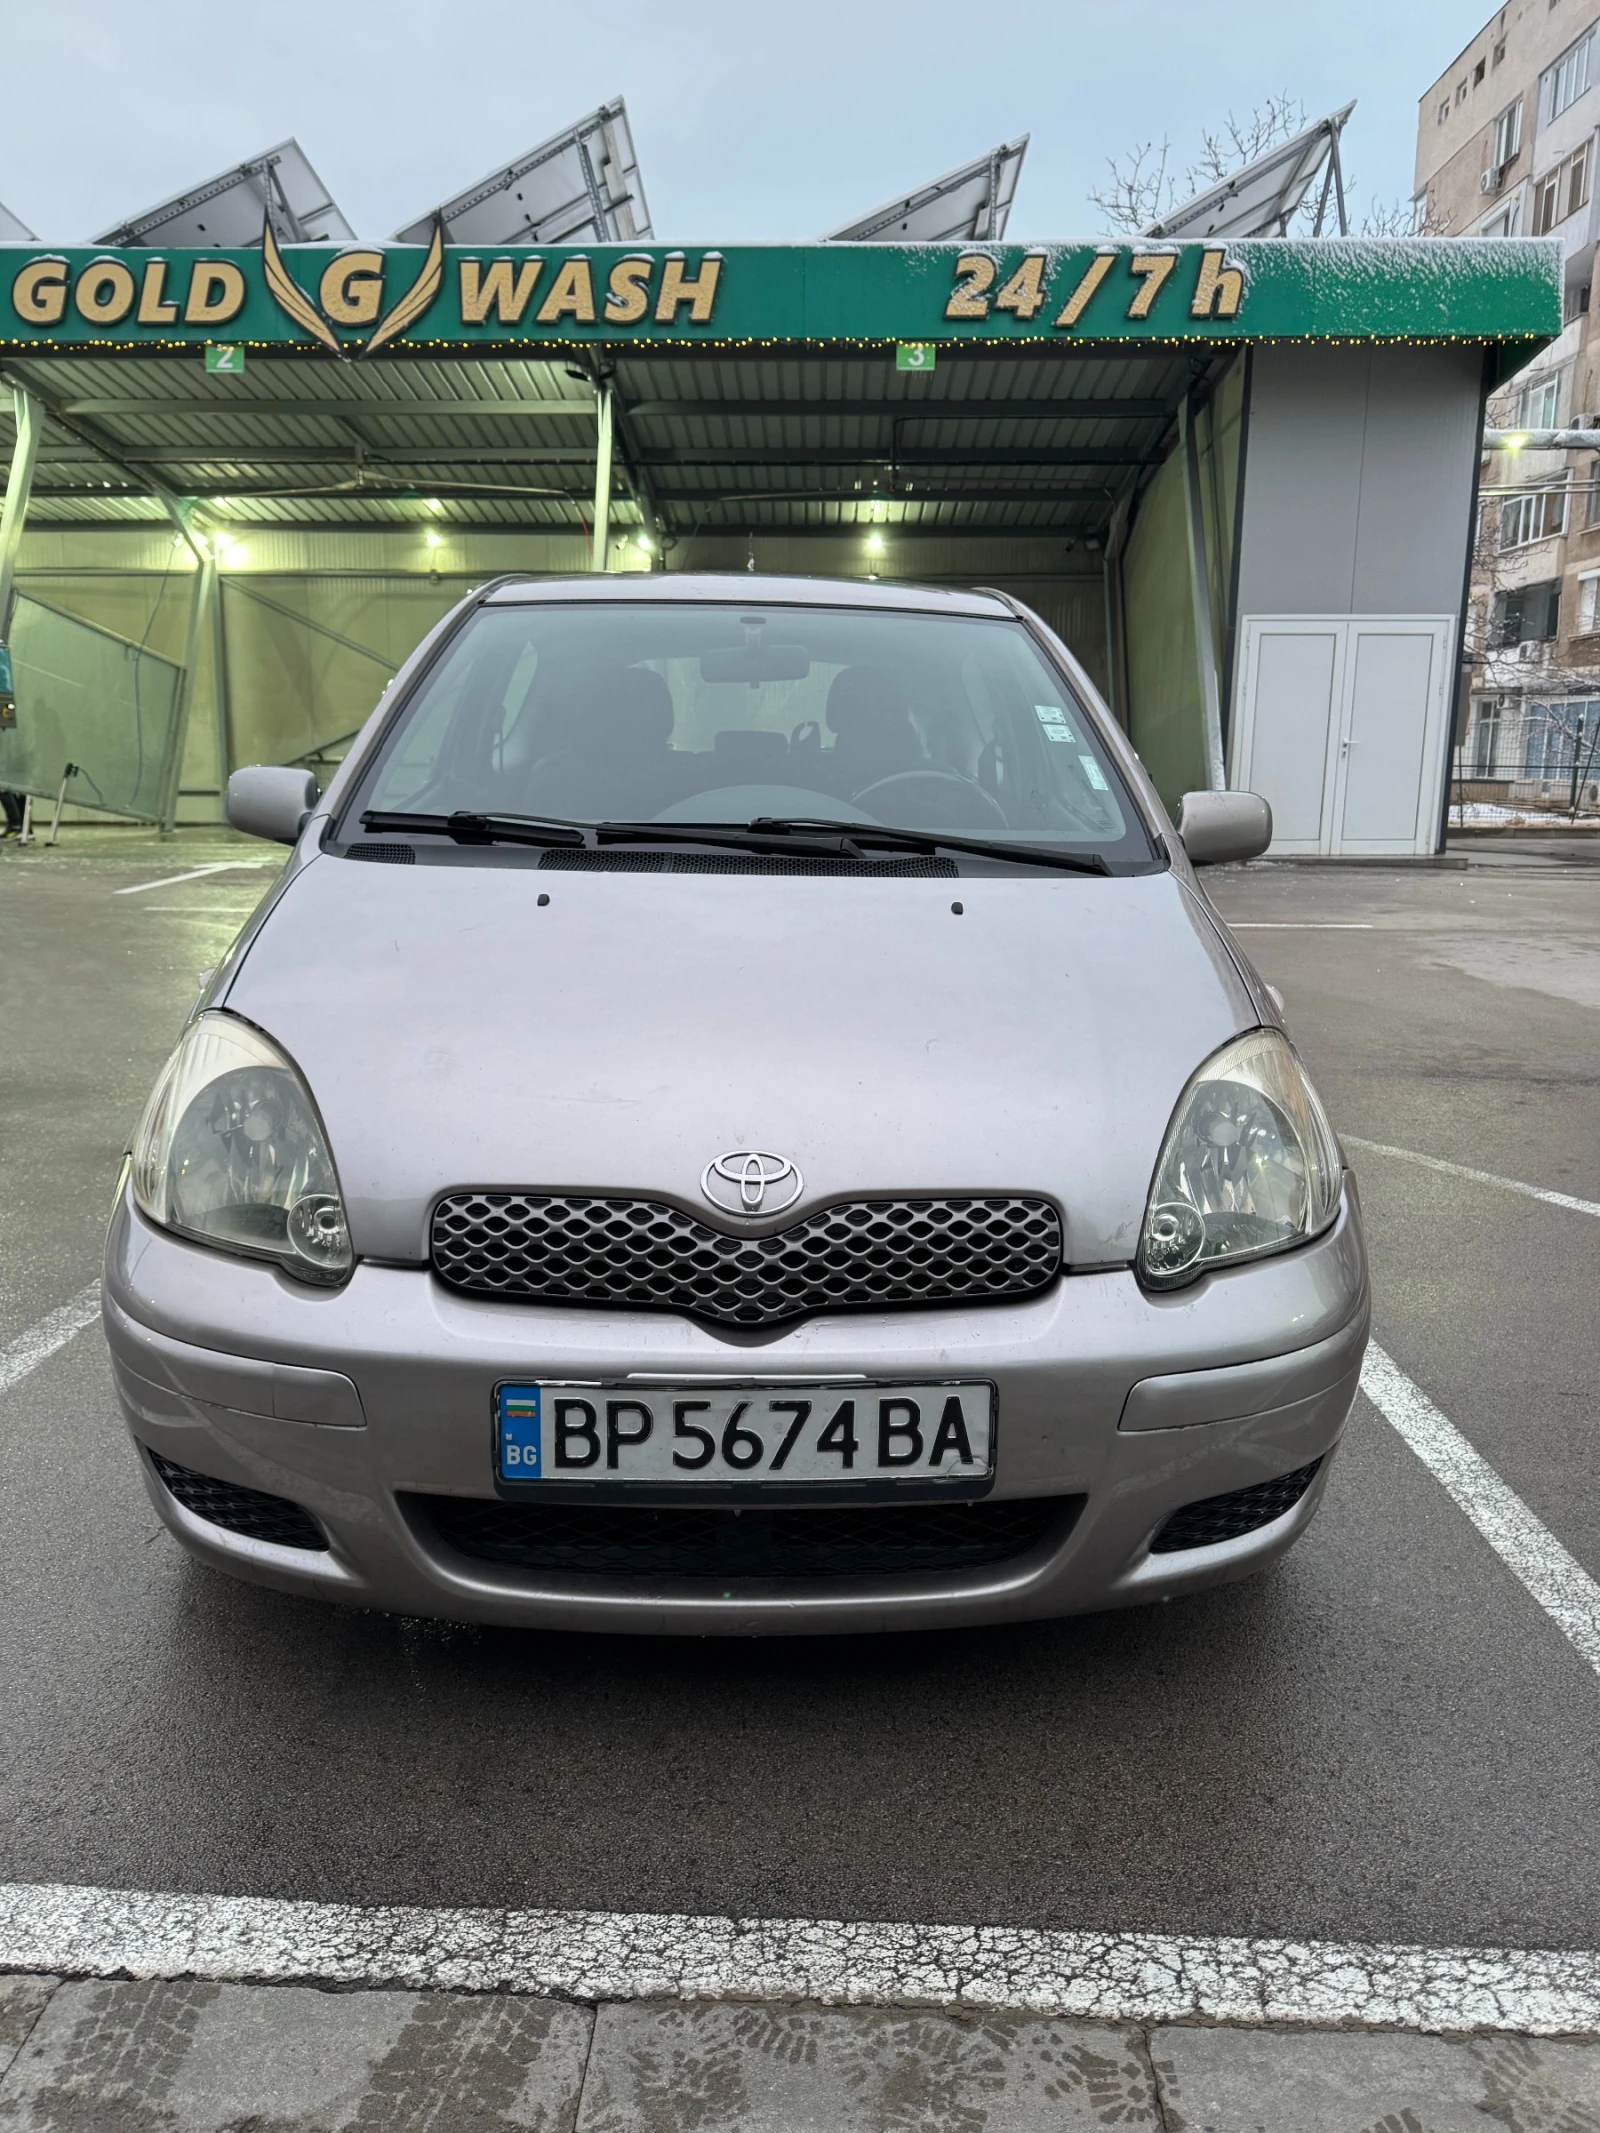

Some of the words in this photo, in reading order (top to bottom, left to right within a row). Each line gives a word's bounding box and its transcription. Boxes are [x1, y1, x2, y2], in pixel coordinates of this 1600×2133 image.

[12, 258, 246, 326] GOLD
[318, 250, 385, 327] G
[458, 254, 724, 326] WASH
[216, 345, 233, 368] 2
[907, 343, 925, 366] 3
[505, 1444, 537, 1467] BG
